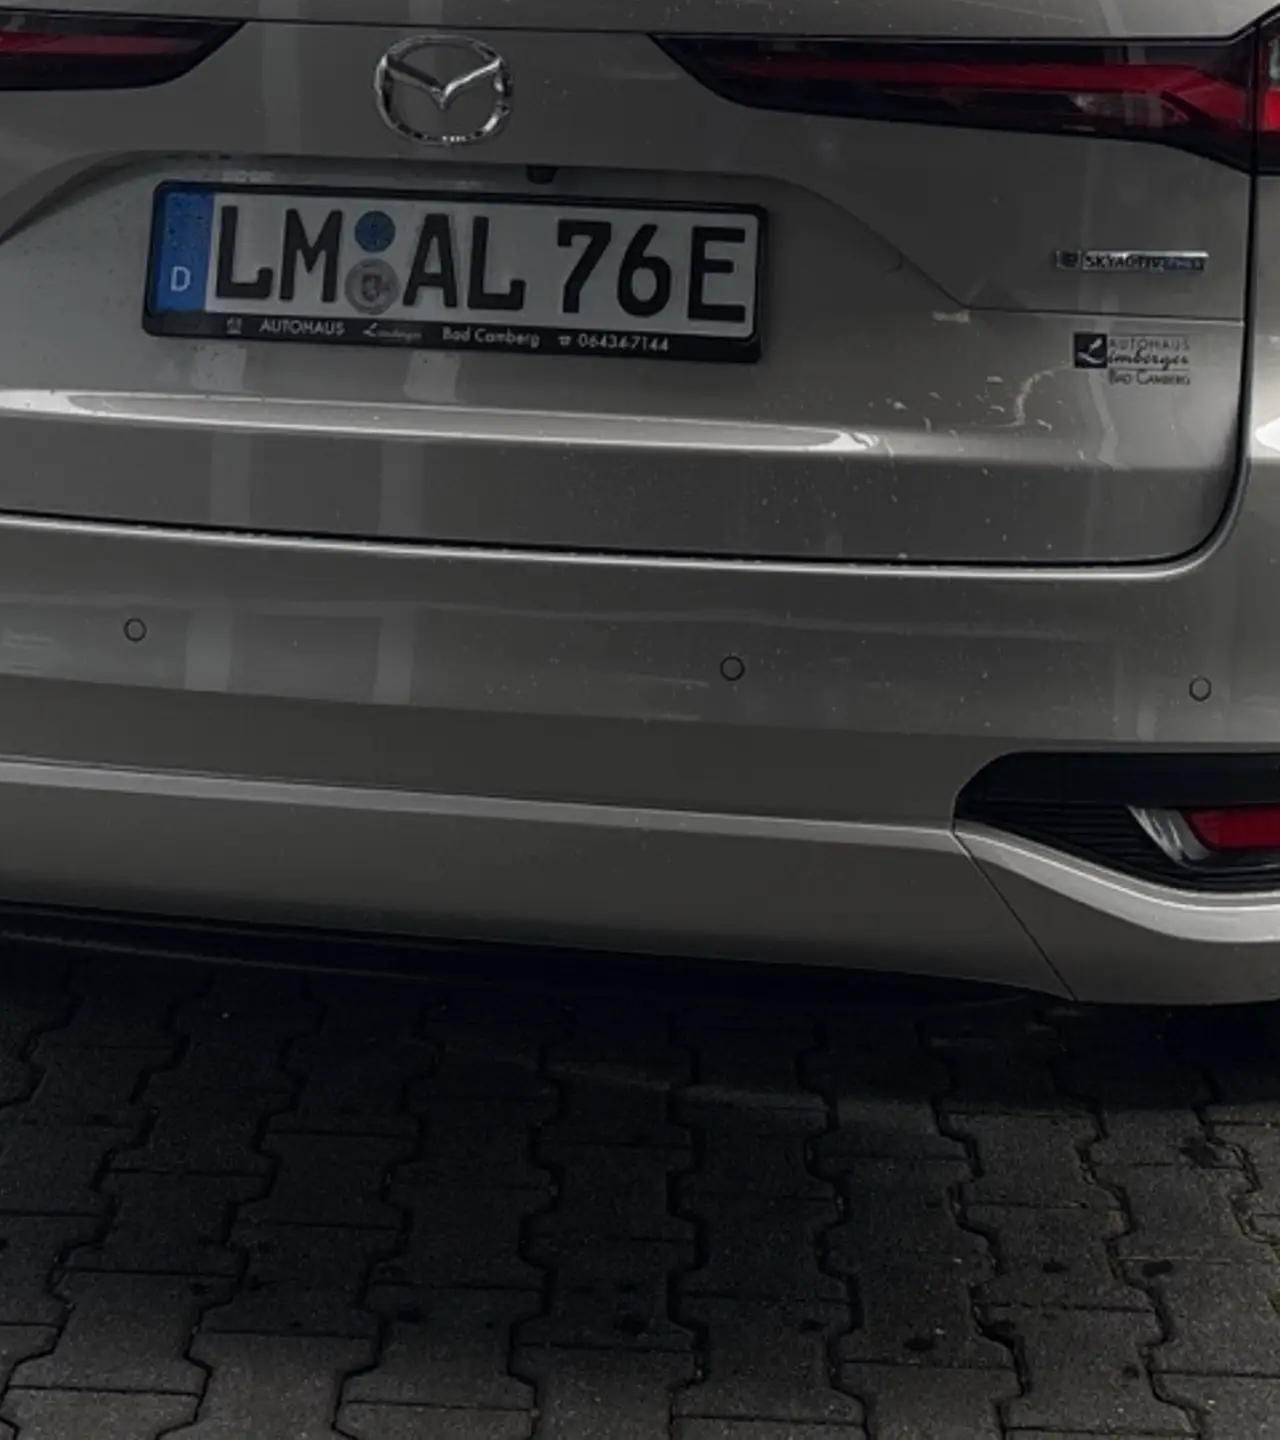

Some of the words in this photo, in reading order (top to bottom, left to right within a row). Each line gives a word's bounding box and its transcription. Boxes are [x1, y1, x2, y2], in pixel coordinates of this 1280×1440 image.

[169, 266, 192, 292] D
[216, 205, 344, 304] LM
[402, 213, 527, 311] AL
[557, 219, 748, 324] 76E
[258, 317, 346, 337] AUTOHAUS
[442, 326, 471, 343] Bad
[474, 328, 540, 348] Camberg
